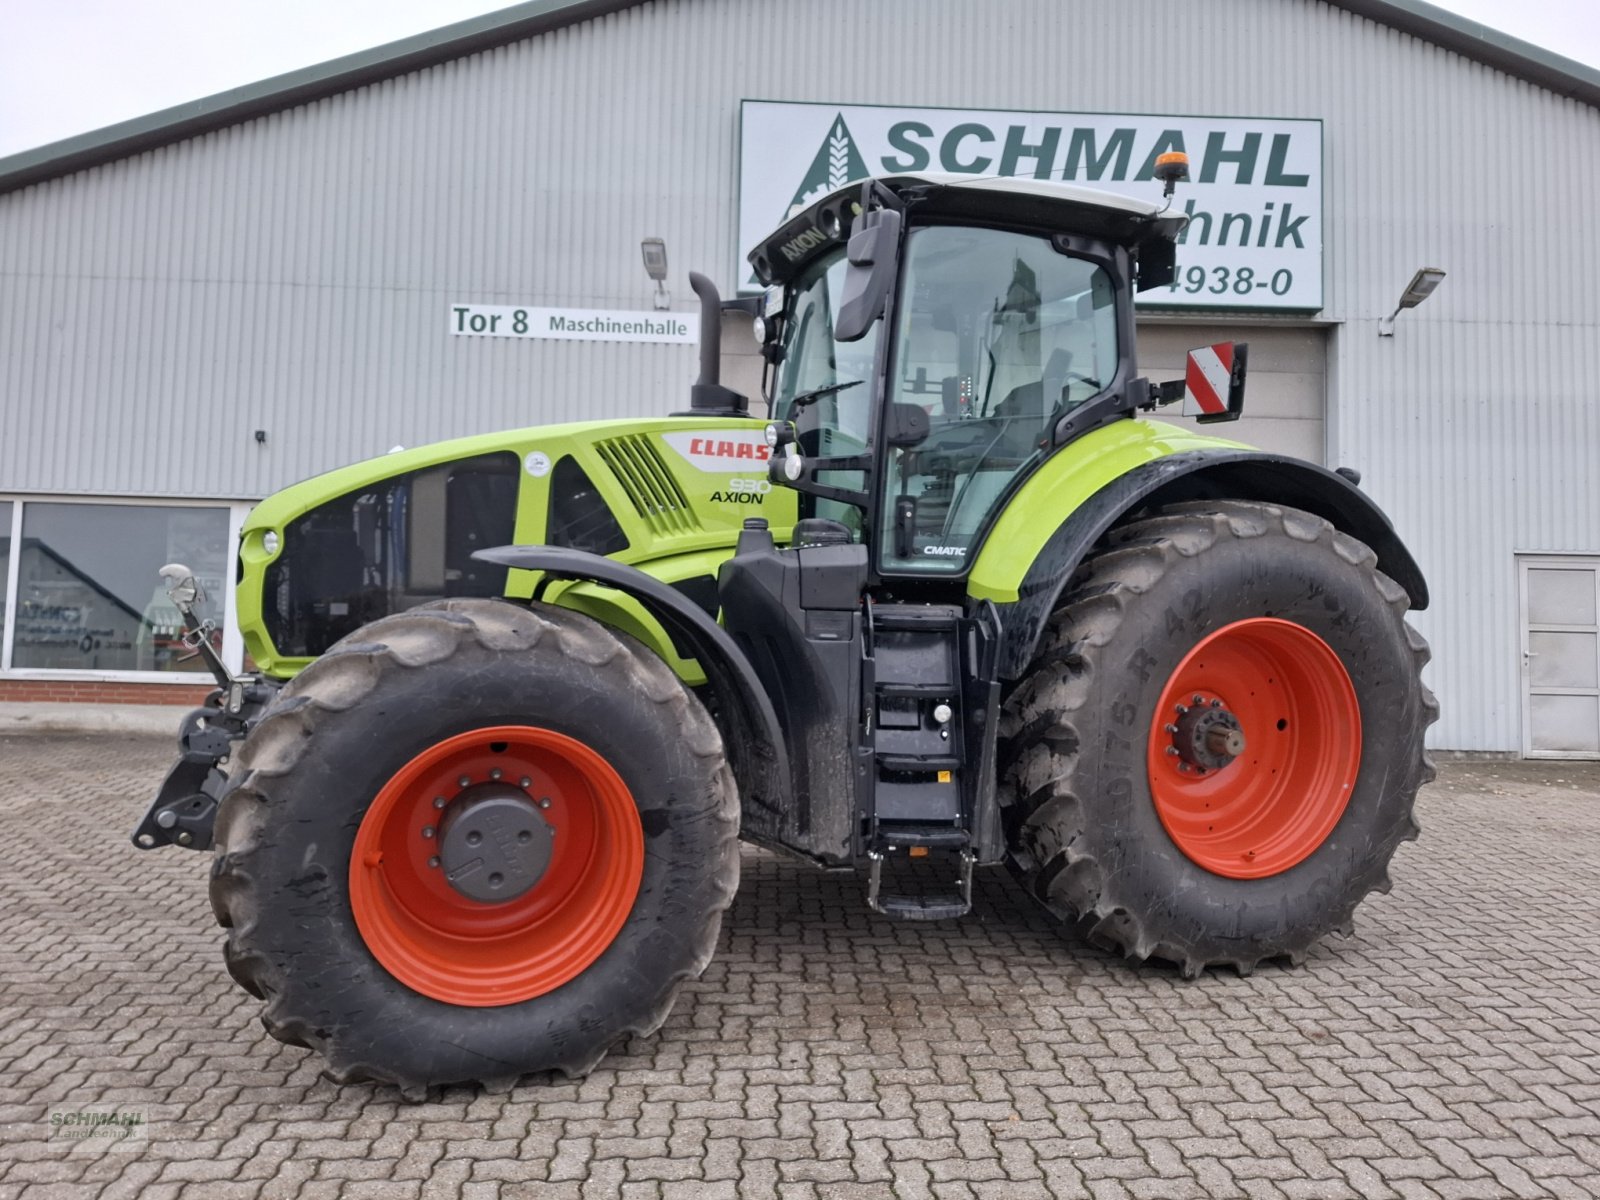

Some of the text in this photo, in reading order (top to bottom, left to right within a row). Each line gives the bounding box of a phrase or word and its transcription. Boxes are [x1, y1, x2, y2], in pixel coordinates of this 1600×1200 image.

[881, 120, 1310, 187] SCHMAHL
[781, 226, 827, 261] AXION
[453, 308, 687, 336] Tor 8 Maschinenhalle
[690, 439, 769, 461] CLAAS
[729, 478, 772, 494] 930
[710, 491, 763, 504] AXION
[924, 546, 967, 556] CMATIC
